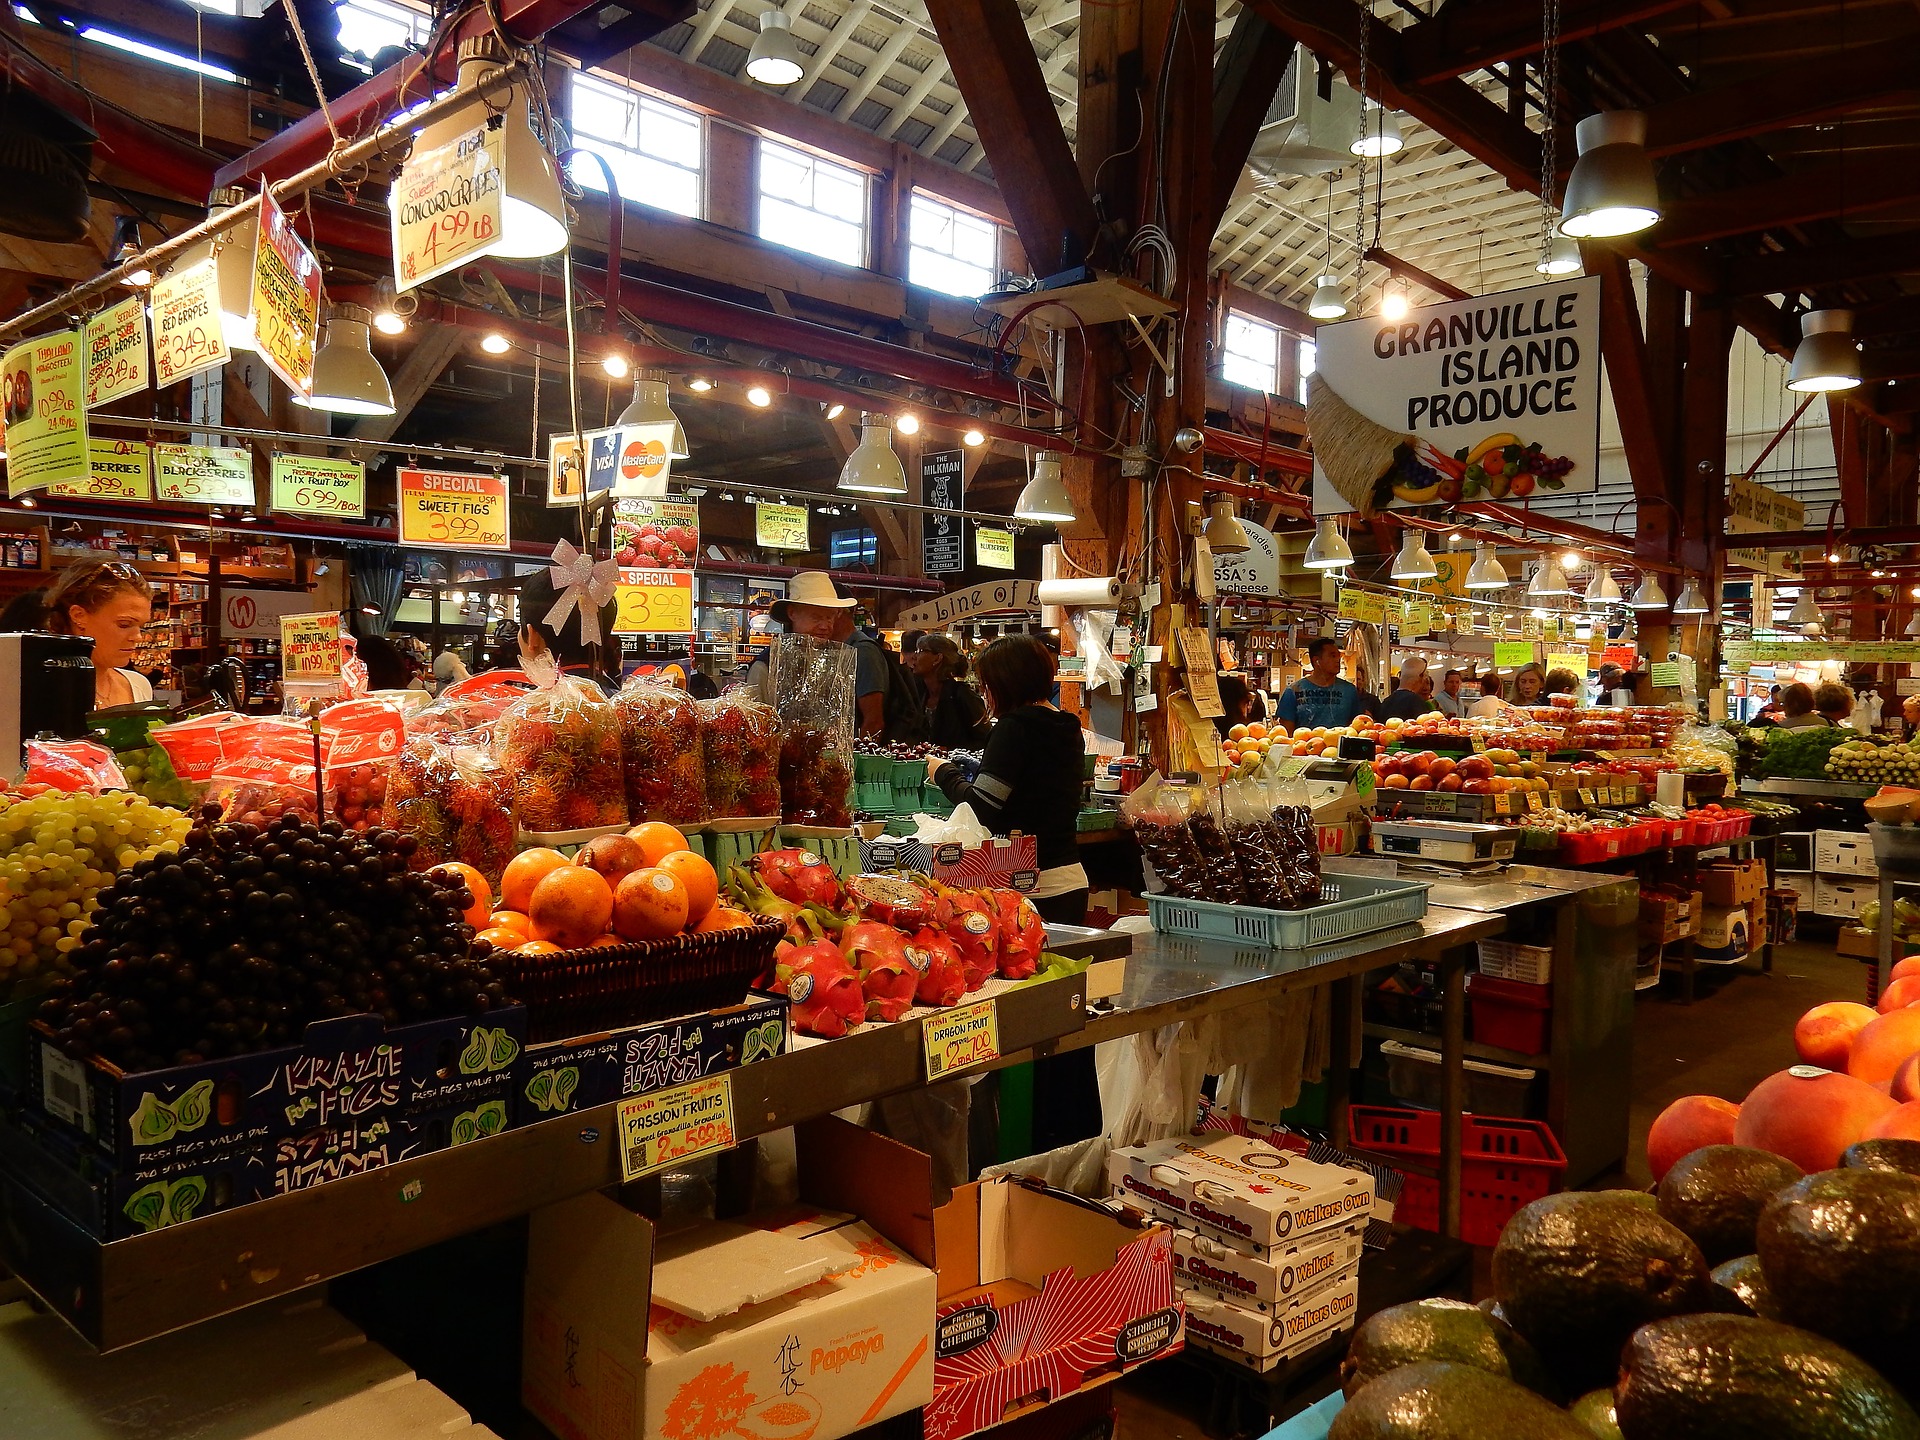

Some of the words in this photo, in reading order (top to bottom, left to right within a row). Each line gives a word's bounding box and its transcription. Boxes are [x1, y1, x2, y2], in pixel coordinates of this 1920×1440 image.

[401, 190, 449, 226] CONCORD
[474, 214, 493, 239] LB
[162, 318, 176, 333] RED
[178, 301, 209, 325] GRAPES
[1374, 292, 1578, 359] GRANVILLE
[37, 342, 73, 361] THAILAND
[92, 346, 113, 365] GREEN
[115, 332, 141, 355] GRAPES
[207, 340, 219, 355] LB
[36, 358, 72, 374] MANGOSTEEN
[129, 366, 138, 380] LB
[1441, 336, 1580, 388] ISLAND
[64, 399, 75, 411] LB
[1408, 376, 1577, 431] PRODUCE
[91, 461, 141, 474] BERRIES
[595, 457, 614, 471] VISA
[622, 453, 666, 468] MasterCard
[924, 461, 960, 476] MILKMAN
[936, 455, 948, 463] THE
[163, 466, 246, 480] BLACKBERRIES
[283, 474, 304, 484] MIX
[308, 477, 330, 486] FRUIT
[333, 477, 349, 487] BOX
[423, 475, 484, 493] SPECIAL
[122, 487, 136, 497] LB
[478, 496, 497, 506] USA
[334, 500, 360, 511] /BOX
[418, 500, 459, 514] SWEET
[463, 503, 490, 515] FIGS
[479, 532, 505, 543] /BOX
[980, 544, 1009, 552] BLUEBERRIES
[628, 572, 676, 586] SPECIAL
[1214, 569, 1257, 582] SSA'S
[1226, 583, 1269, 593] cheese
[935, 590, 983, 622] Line
[1027, 582, 1041, 606] L
[293, 632, 330, 643] RAMBUTANS
[682, 1027, 703, 1051] FOR
[934, 1023, 966, 1042] DRAGON
[967, 1016, 989, 1032] FRUIT
[625, 1026, 682, 1063] FIGS
[946, 1043, 960, 1071] 2
[957, 1053, 971, 1065] FOR
[286, 1045, 402, 1095] KRAZIE
[623, 1051, 701, 1095] KRAZIE
[412, 1089, 437, 1101] FRESH
[440, 1083, 462, 1095] FIGS
[466, 1077, 492, 1089] VALUE
[495, 1072, 511, 1083] PAK
[320, 1081, 401, 1125] FIGS
[625, 1099, 655, 1115] Fresh
[628, 1107, 680, 1133] PASSION
[682, 1094, 723, 1116] FRUITS
[139, 1151, 171, 1163] FRESH
[176, 1141, 204, 1155] FIGS
[210, 1132, 244, 1147] VALUE
[249, 1126, 269, 1139] PAK
[633, 1131, 656, 1146] (Sweet
[656, 1135, 671, 1164] 2
[1174, 1142, 1258, 1176] Walkers
[1258, 1173, 1312, 1193] Own
[1123, 1174, 1186, 1212] Canadian
[1189, 1201, 1253, 1238] Cherries
[1295, 1202, 1342, 1229] Walkers
[1344, 1191, 1370, 1211] Own
[1188, 1256, 1257, 1295] Cherries
[1296, 1252, 1335, 1284] Walkers
[1202, 1277, 1248, 1300] CHERRIES
[942, 1314, 985, 1337] CANADIAN
[952, 1311, 975, 1324] FRESH
[1127, 1314, 1170, 1339] CHERRIES
[1286, 1304, 1330, 1337] Walkers
[1331, 1292, 1355, 1315] Own
[940, 1325, 987, 1349] CHERRIES
[1128, 1326, 1168, 1352] CANADIAN
[1186, 1312, 1245, 1348] herries
[810, 1333, 884, 1375] Papaya
[1137, 1341, 1159, 1356] FRESH
